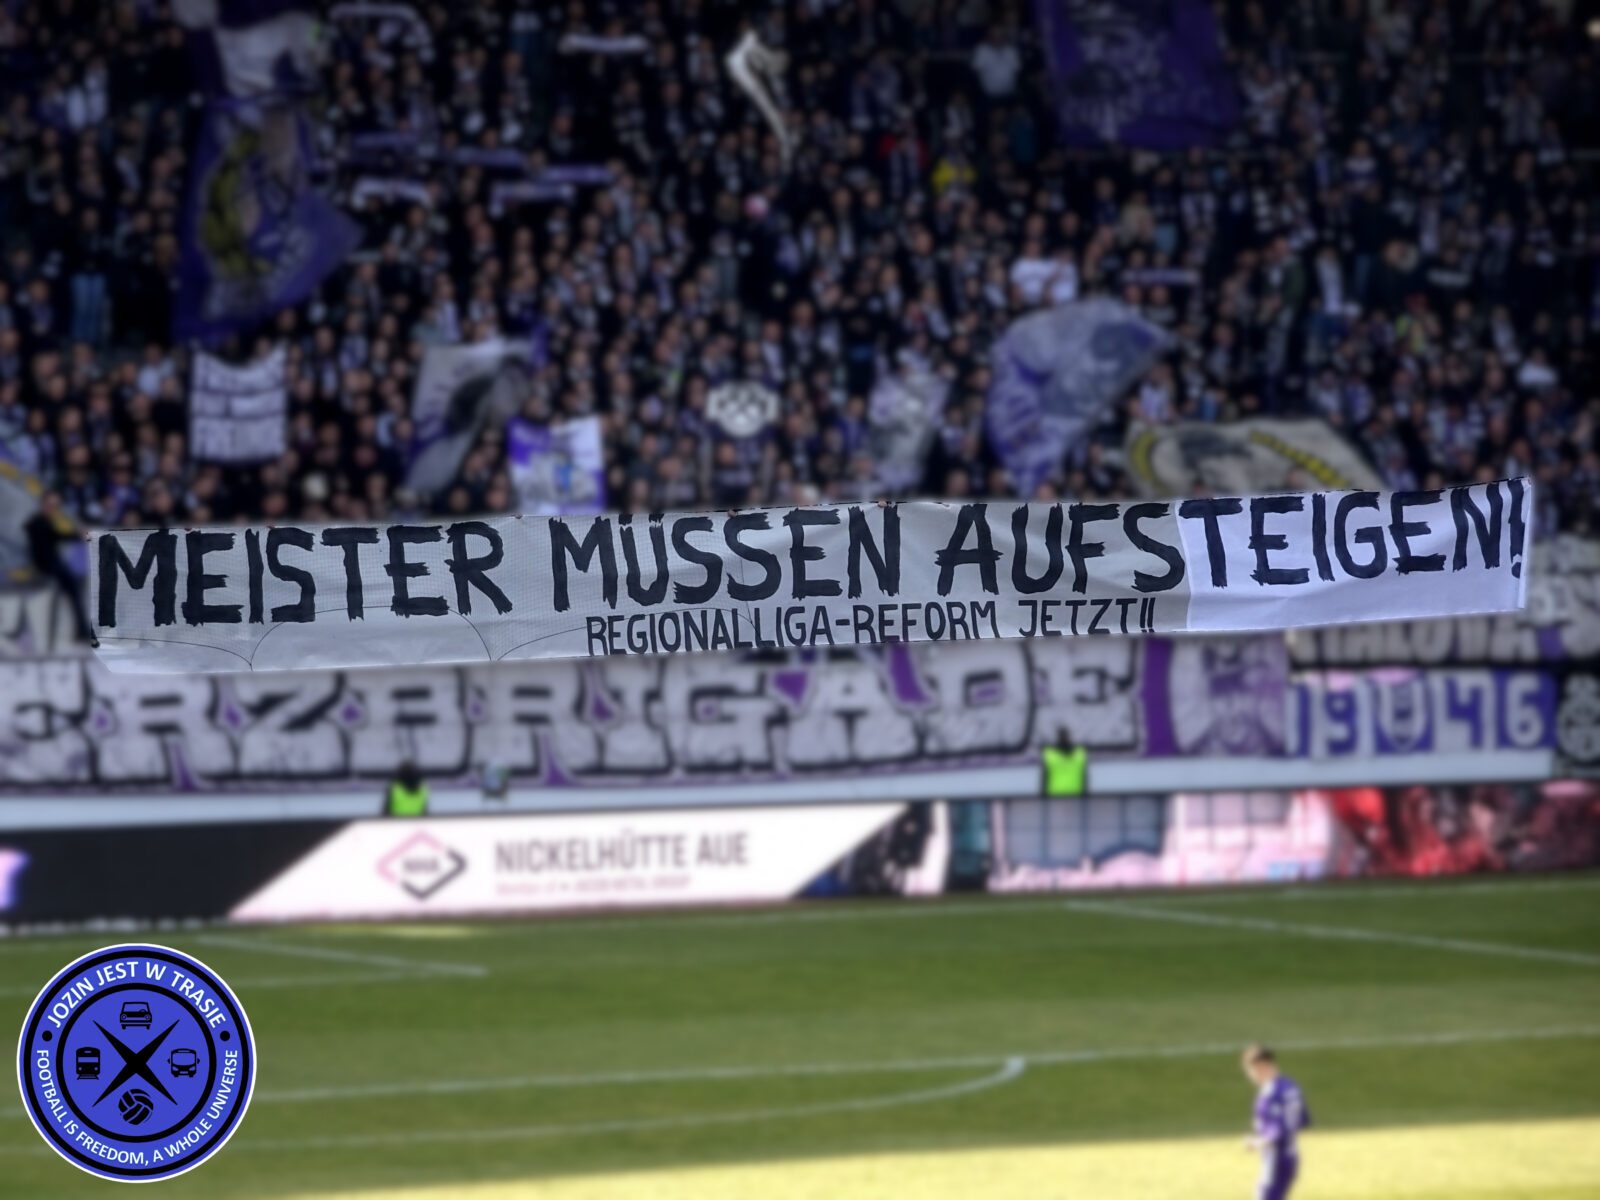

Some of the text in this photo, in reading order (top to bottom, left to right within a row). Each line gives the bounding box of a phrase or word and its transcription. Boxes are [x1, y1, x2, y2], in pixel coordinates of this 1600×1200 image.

[99, 521, 513, 628] MEISTER
[549, 503, 901, 613] MÜSSEN
[934, 476, 1529, 597] AUFSTEIGEN!
[586, 597, 1157, 657] REGIONALLIGA-REFORM JETZT!!
[494, 828, 750, 875] NICKELHÜTTE AUE
